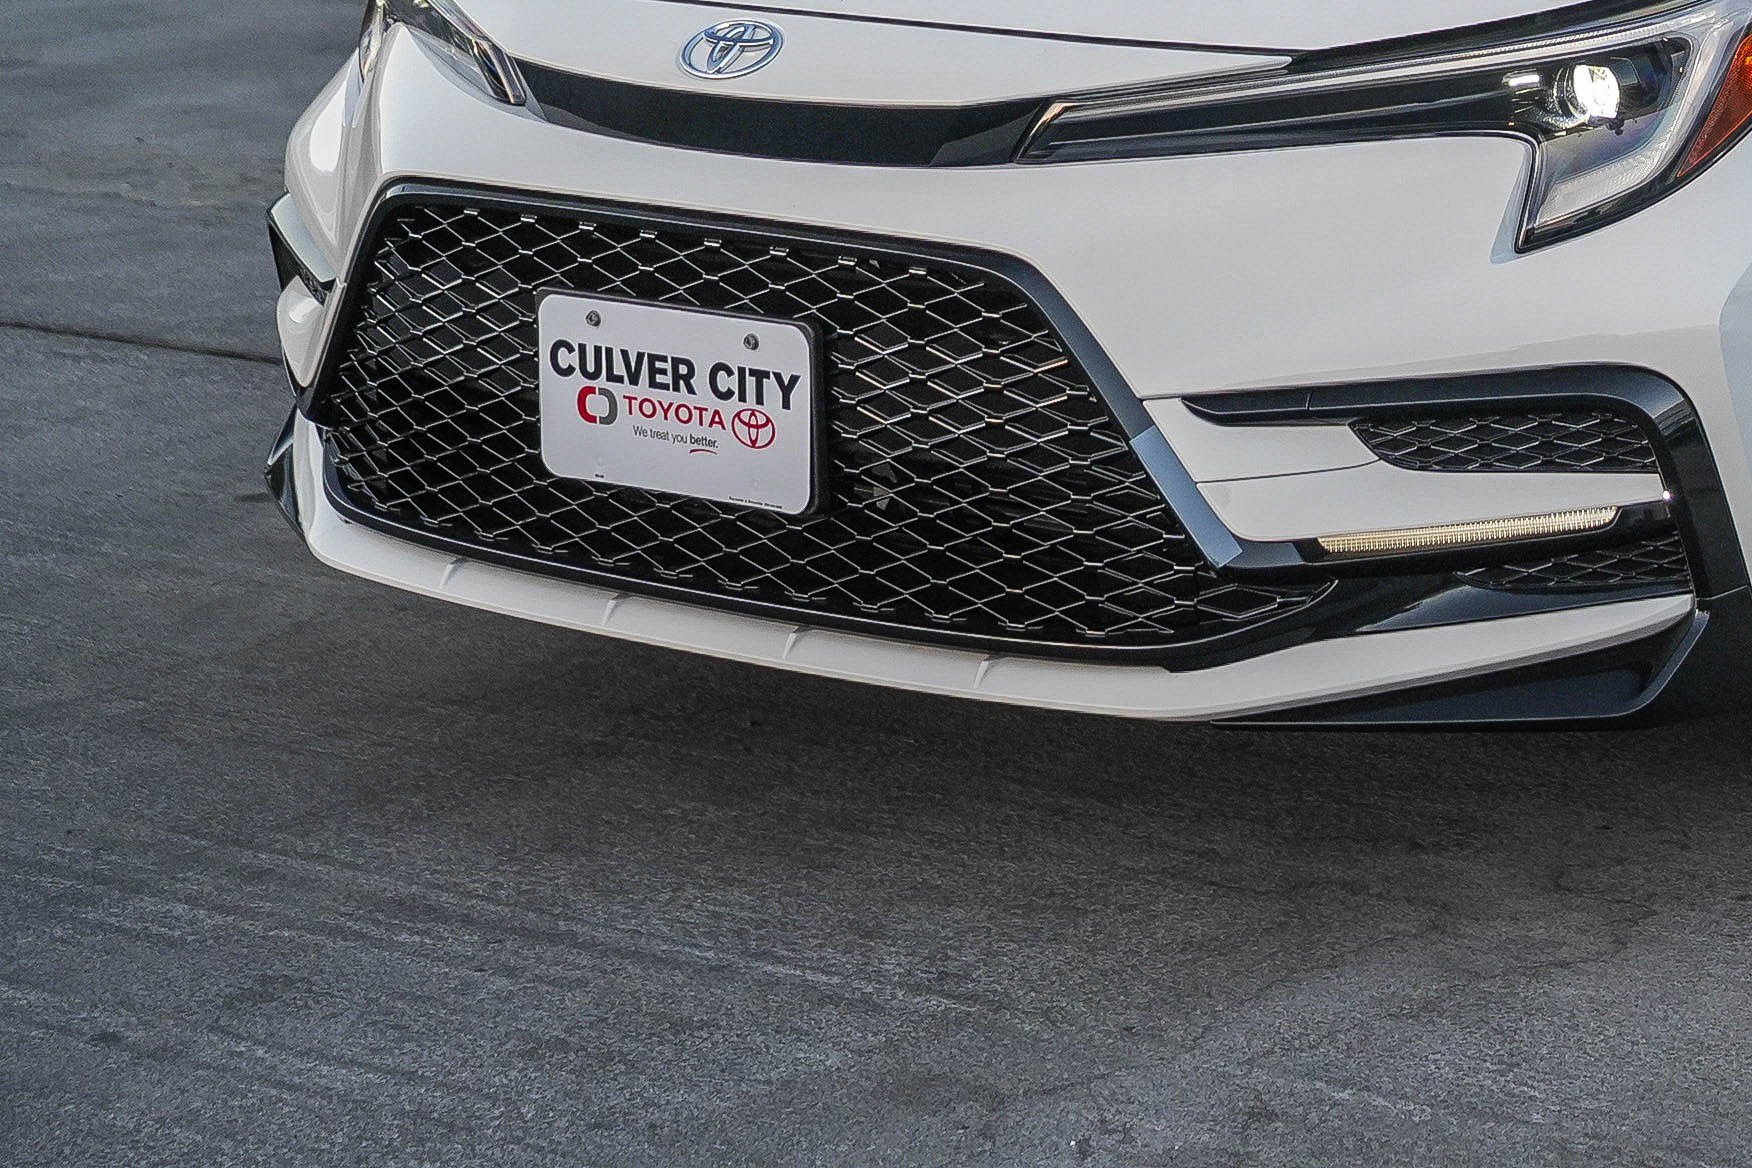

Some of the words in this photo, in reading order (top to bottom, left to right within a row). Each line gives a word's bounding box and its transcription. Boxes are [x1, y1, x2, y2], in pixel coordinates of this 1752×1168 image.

[549, 338, 698, 396] CULVER
[708, 361, 801, 411] CITY
[623, 394, 727, 431] TOYOTA
[632, 424, 649, 437] We
[649, 428, 670, 441] treat
[670, 432, 688, 445] you
[689, 432, 719, 449] better.
